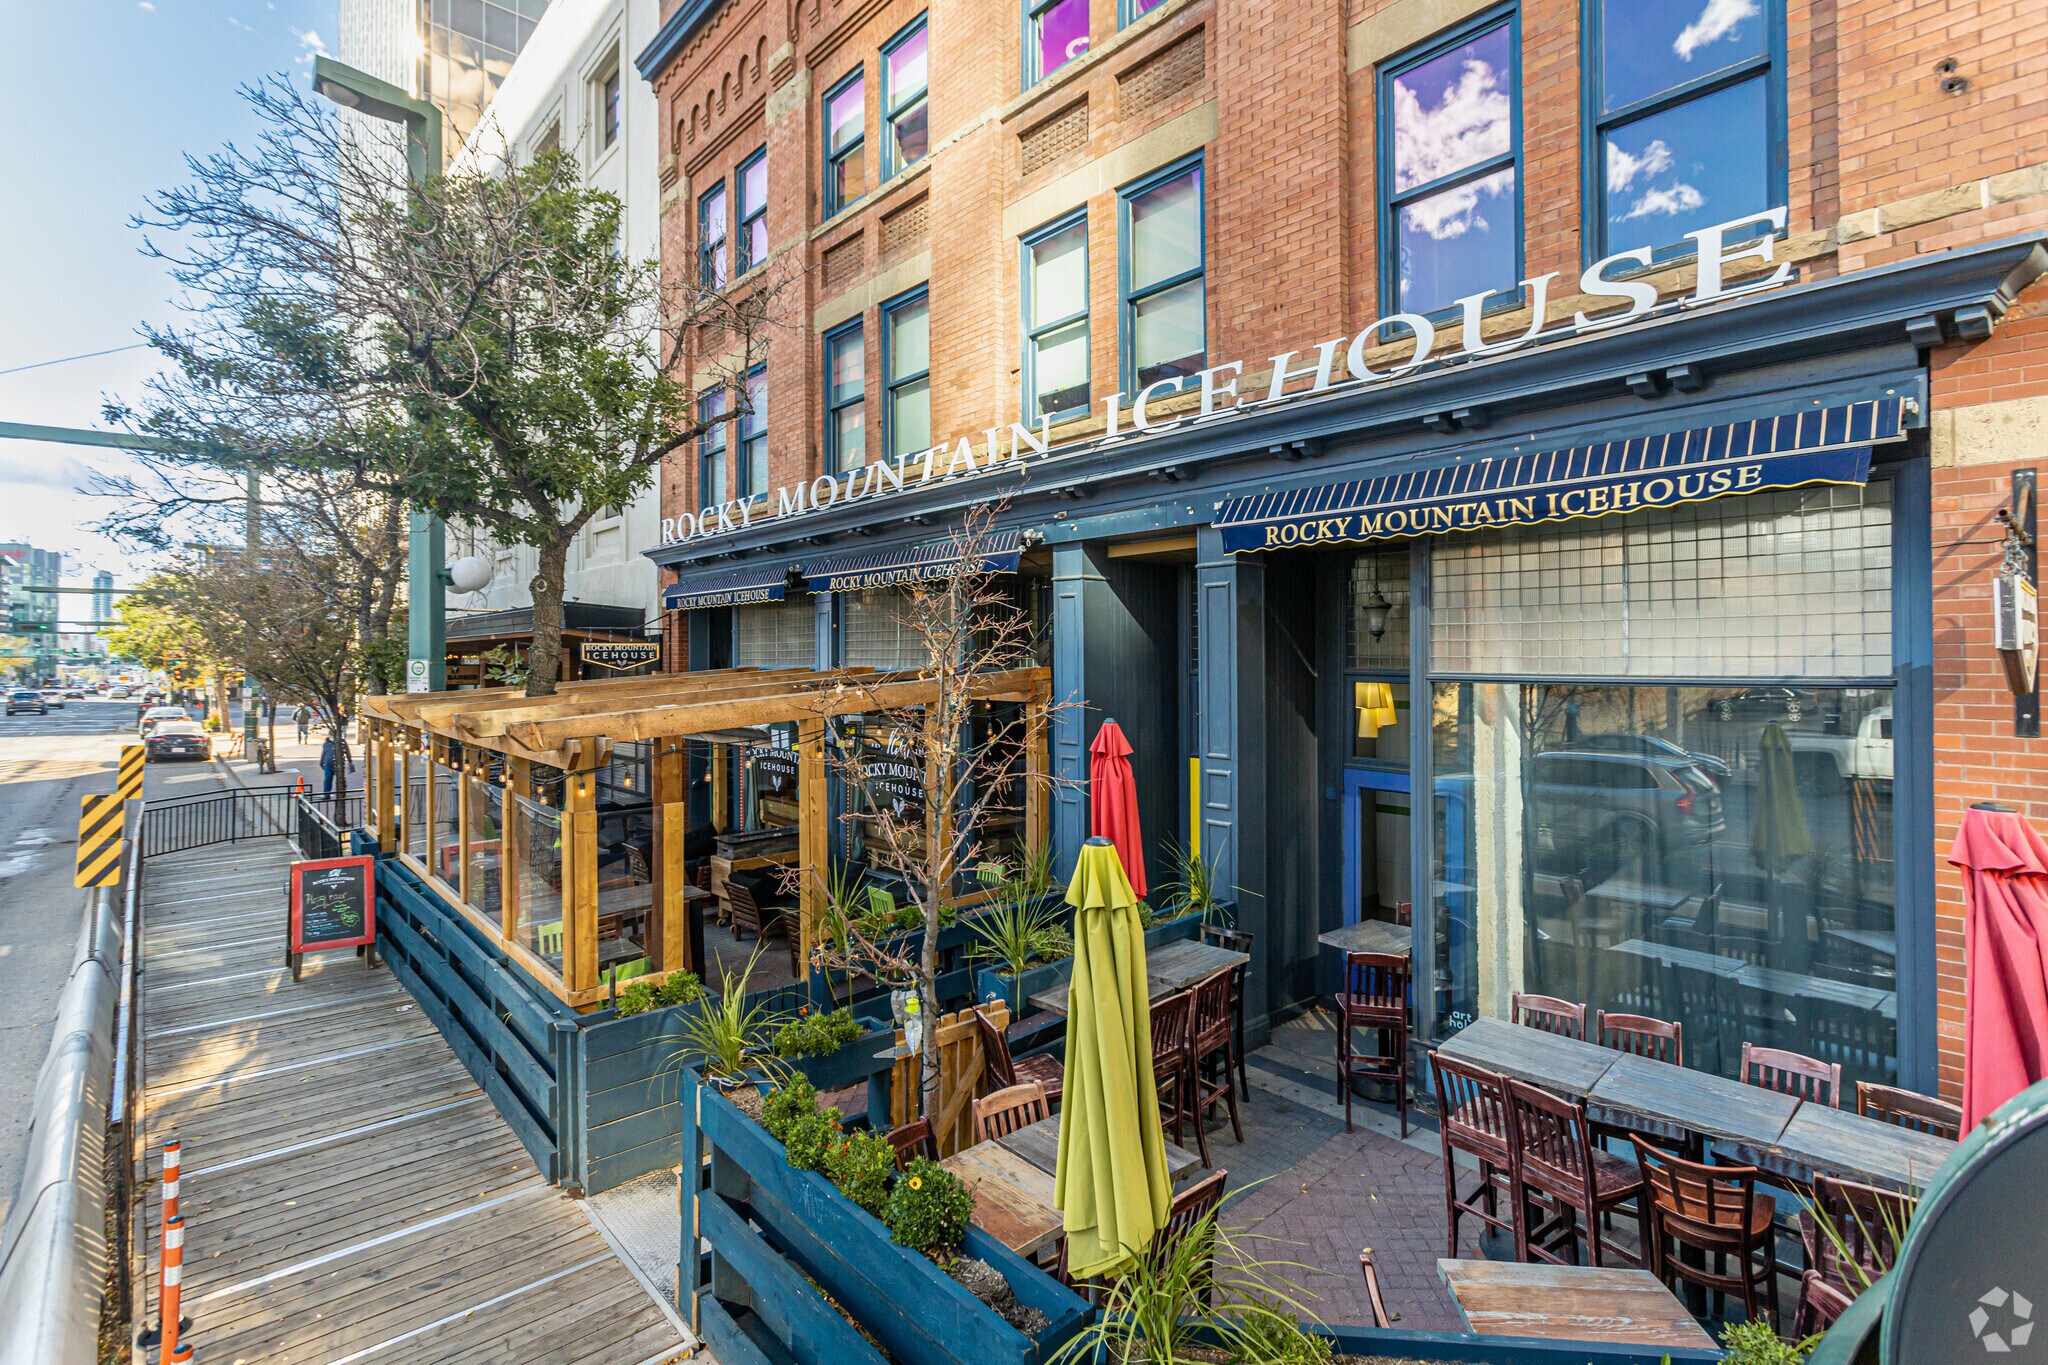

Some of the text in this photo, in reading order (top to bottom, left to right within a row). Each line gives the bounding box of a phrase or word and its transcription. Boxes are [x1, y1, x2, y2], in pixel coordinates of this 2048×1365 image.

[661, 205, 1794, 545] ROCKY MOUNTAIN ICEHOUSE
[1264, 464, 1764, 546] ROCKY MOUNTAIN ICEHOUSE
[829, 559, 985, 590] ROCKY MOUNTAIN ICEHOSE
[677, 588, 770, 608] ROCKY MOUNTAIN ICEHOUSE
[760, 761, 795, 775] ICEHOUSE
[858, 762, 887, 777] OCKY
[1453, 1011, 1472, 1022] art
